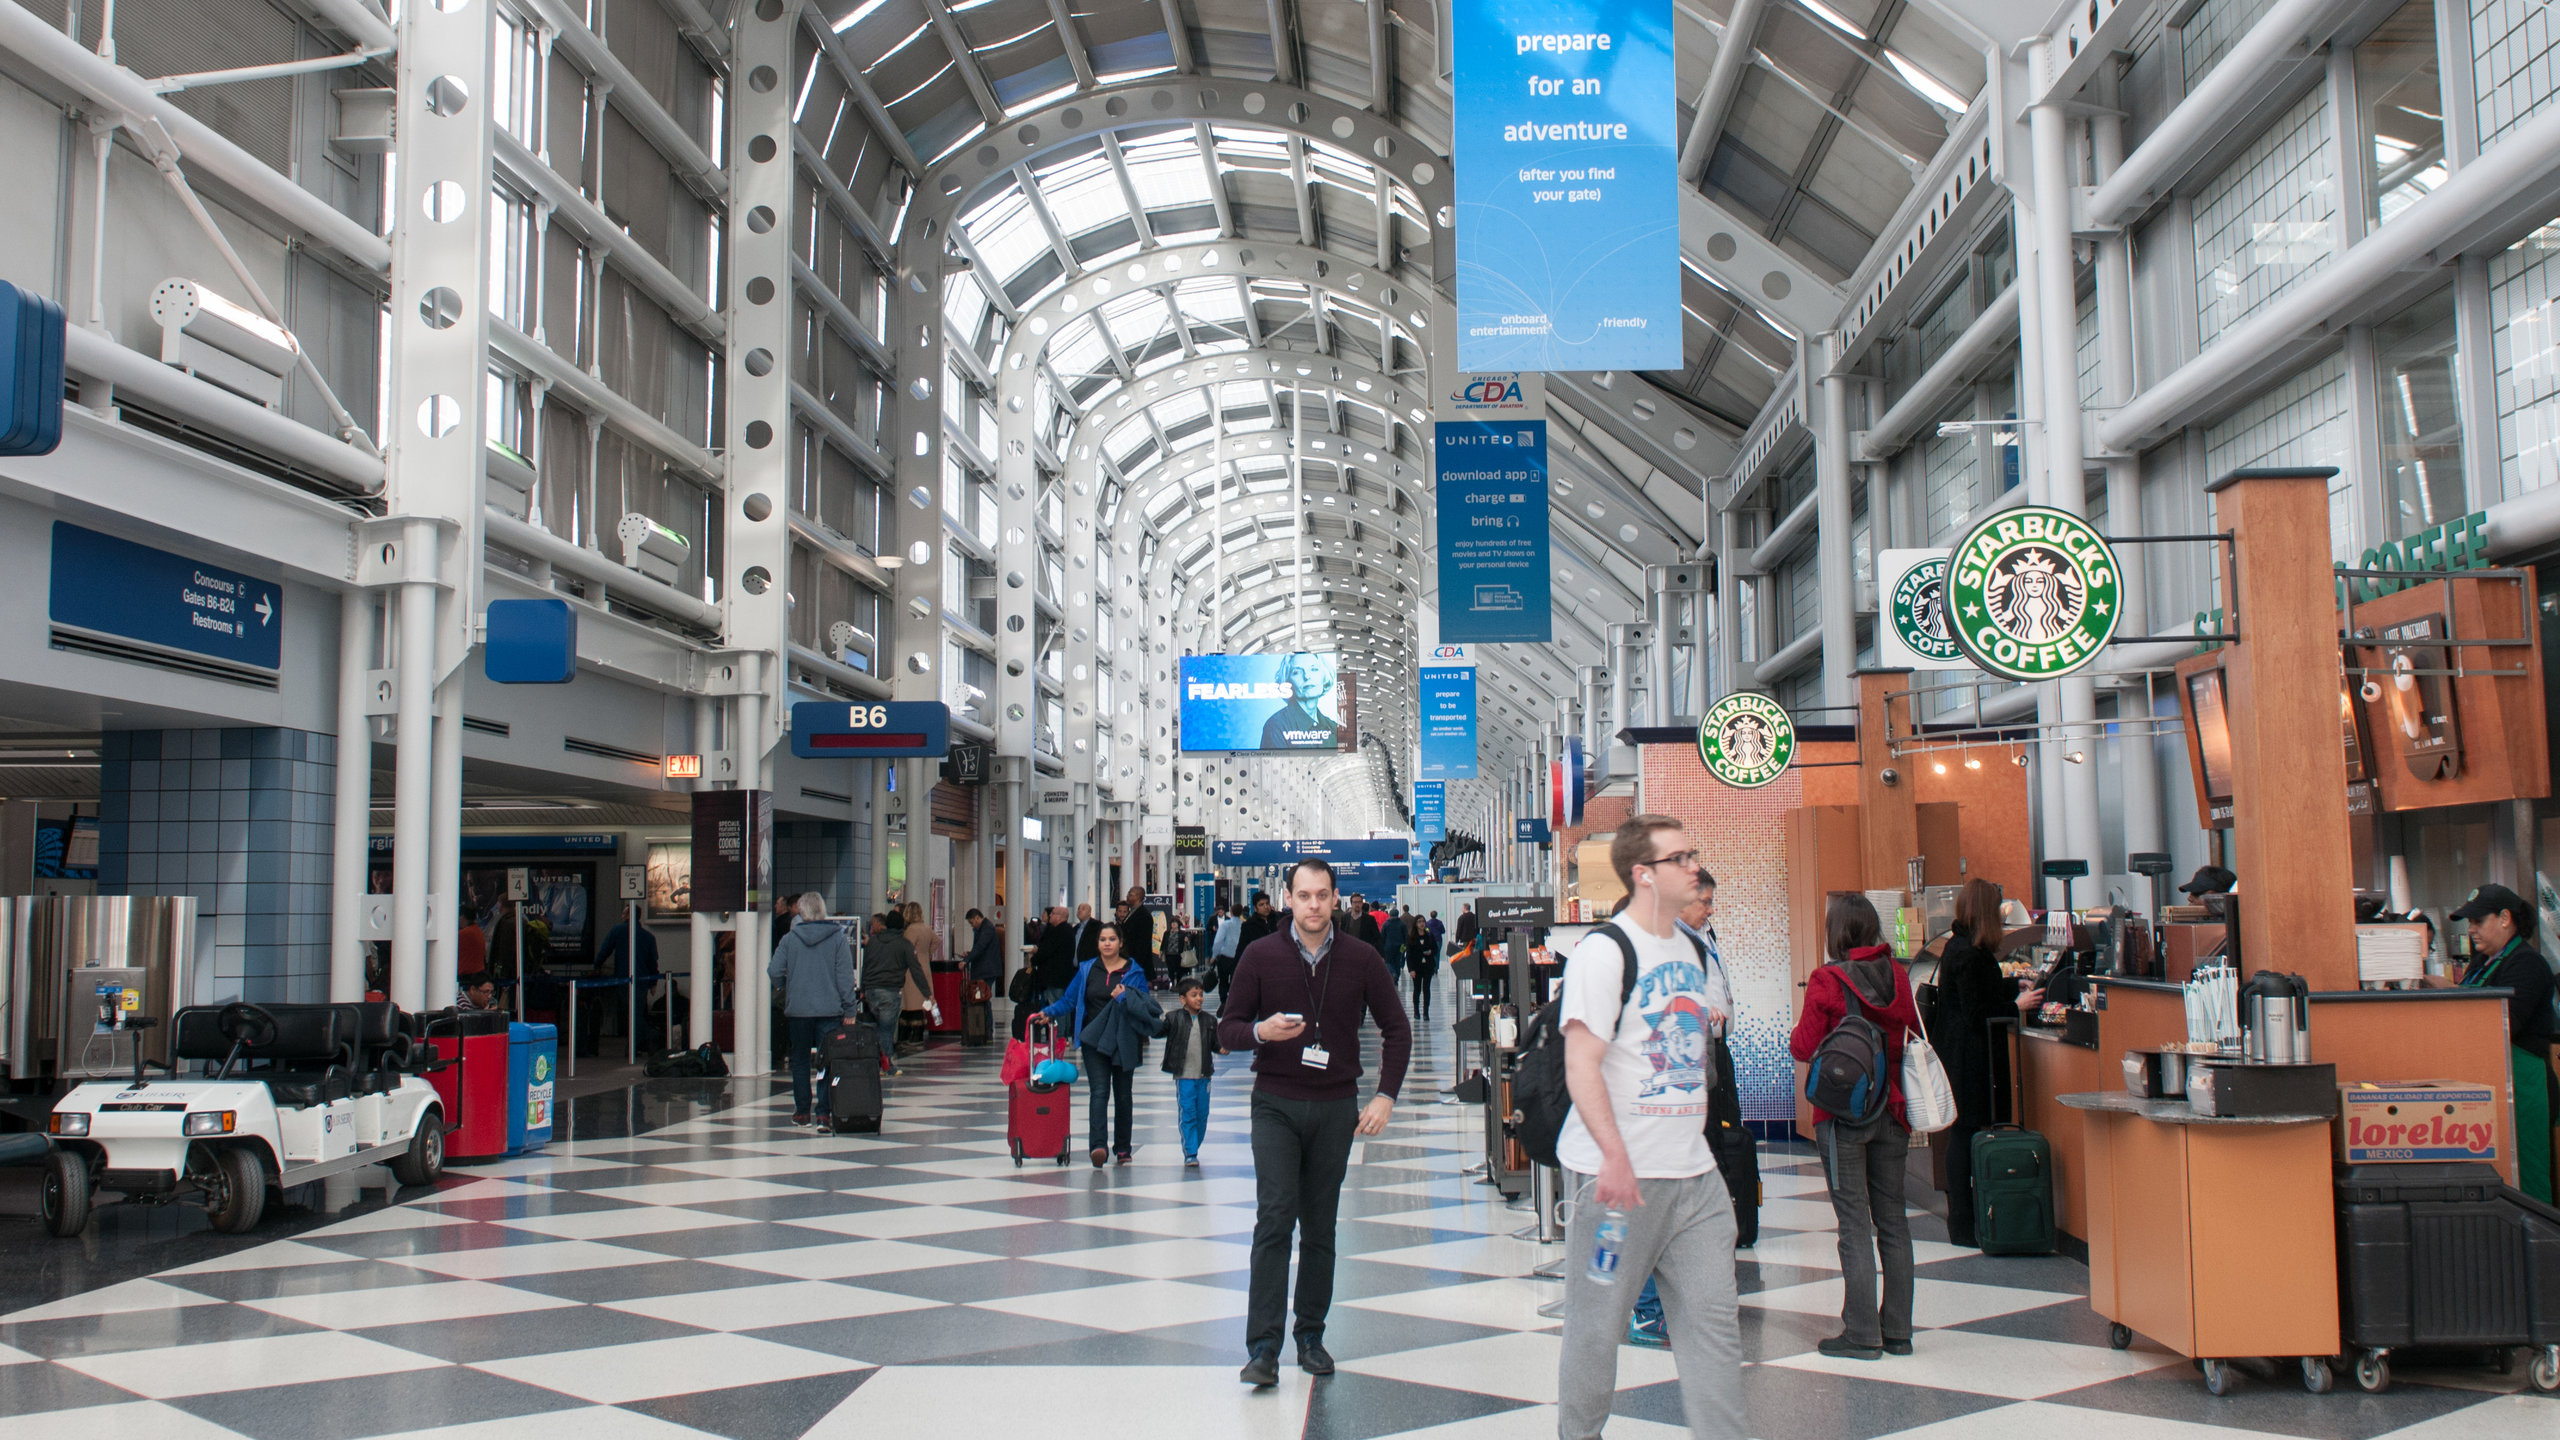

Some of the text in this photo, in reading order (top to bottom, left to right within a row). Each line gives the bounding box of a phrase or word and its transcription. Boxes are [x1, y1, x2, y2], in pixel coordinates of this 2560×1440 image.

[1517, 33, 1611, 55] prepare
[1528, 76, 1600, 96] for an
[1504, 121, 1628, 142] adventure
[1519, 168, 1615, 182] (after you find
[1533, 188, 1601, 203] your gate)
[1501, 314, 1547, 325] onboard
[1603, 317, 1648, 329] friendly
[1469, 325, 1548, 337] entertainment
[1463, 381, 1523, 403] CDA
[1445, 435, 1513, 446] UNITED
[1442, 470, 1527, 482] download app
[1465, 493, 1505, 505] charge
[1472, 516, 1504, 528] bring
[1455, 539, 1532, 548] enjoy hundreds of free
[1478, 550, 1491, 558] and
[1958, 516, 2112, 590] STARBUCKS
[2359, 510, 2491, 603] COFFEE
[1476, 561, 1506, 569] personal
[194, 570, 235, 594] Concourse
[1897, 563, 1945, 606] STARB
[183, 588, 235, 615] Gates B6-B24
[193, 611, 233, 634] Restrooms
[2385, 619, 2431, 640] LATTE MACCHIATO
[1908, 630, 1955, 656] COFF
[1976, 625, 2098, 670] COFFEE
[1434, 647, 1464, 658] CDA
[1188, 682, 1293, 700] FEARLESS
[850, 705, 887, 728] B6
[1705, 697, 1790, 739] STARBUCKS
[1282, 730, 1329, 740] vmware
[670, 756, 698, 772] EXIT
[1715, 757, 1782, 782] COFFEE
[719, 838, 740, 849] COOKING
[1176, 839, 1204, 848] PUCK
[514, 880, 522, 891] 4
[628, 878, 637, 890] 5
[1488, 909, 1501, 918] Grab
[529, 1088, 552, 1100] RECYCLE
[2350, 1093, 2388, 1101] BANANAS
[2435, 1092, 2490, 1100] EXPORTACION
[144, 1103, 164, 1111] Car
[2349, 1115, 2493, 1152] lorelay
[2366, 1149, 2414, 1159] MEXICO
